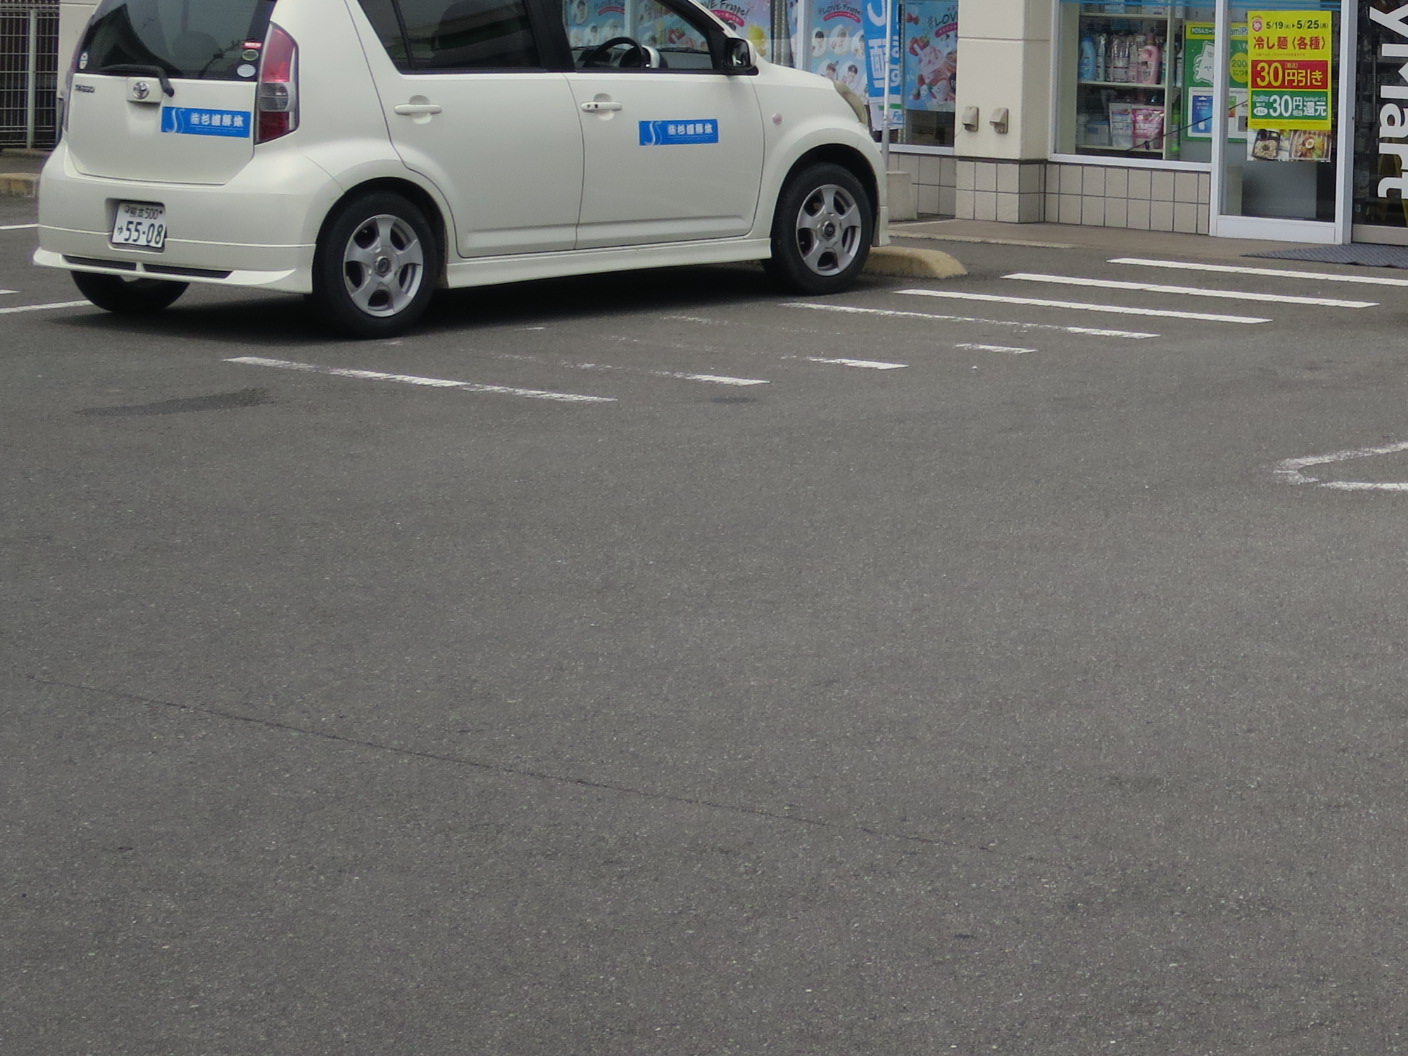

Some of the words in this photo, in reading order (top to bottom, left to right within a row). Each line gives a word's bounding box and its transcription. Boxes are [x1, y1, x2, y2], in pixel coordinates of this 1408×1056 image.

[1256, 62, 1323, 86] 30円引き
[124, 220, 164, 245] 55-08
